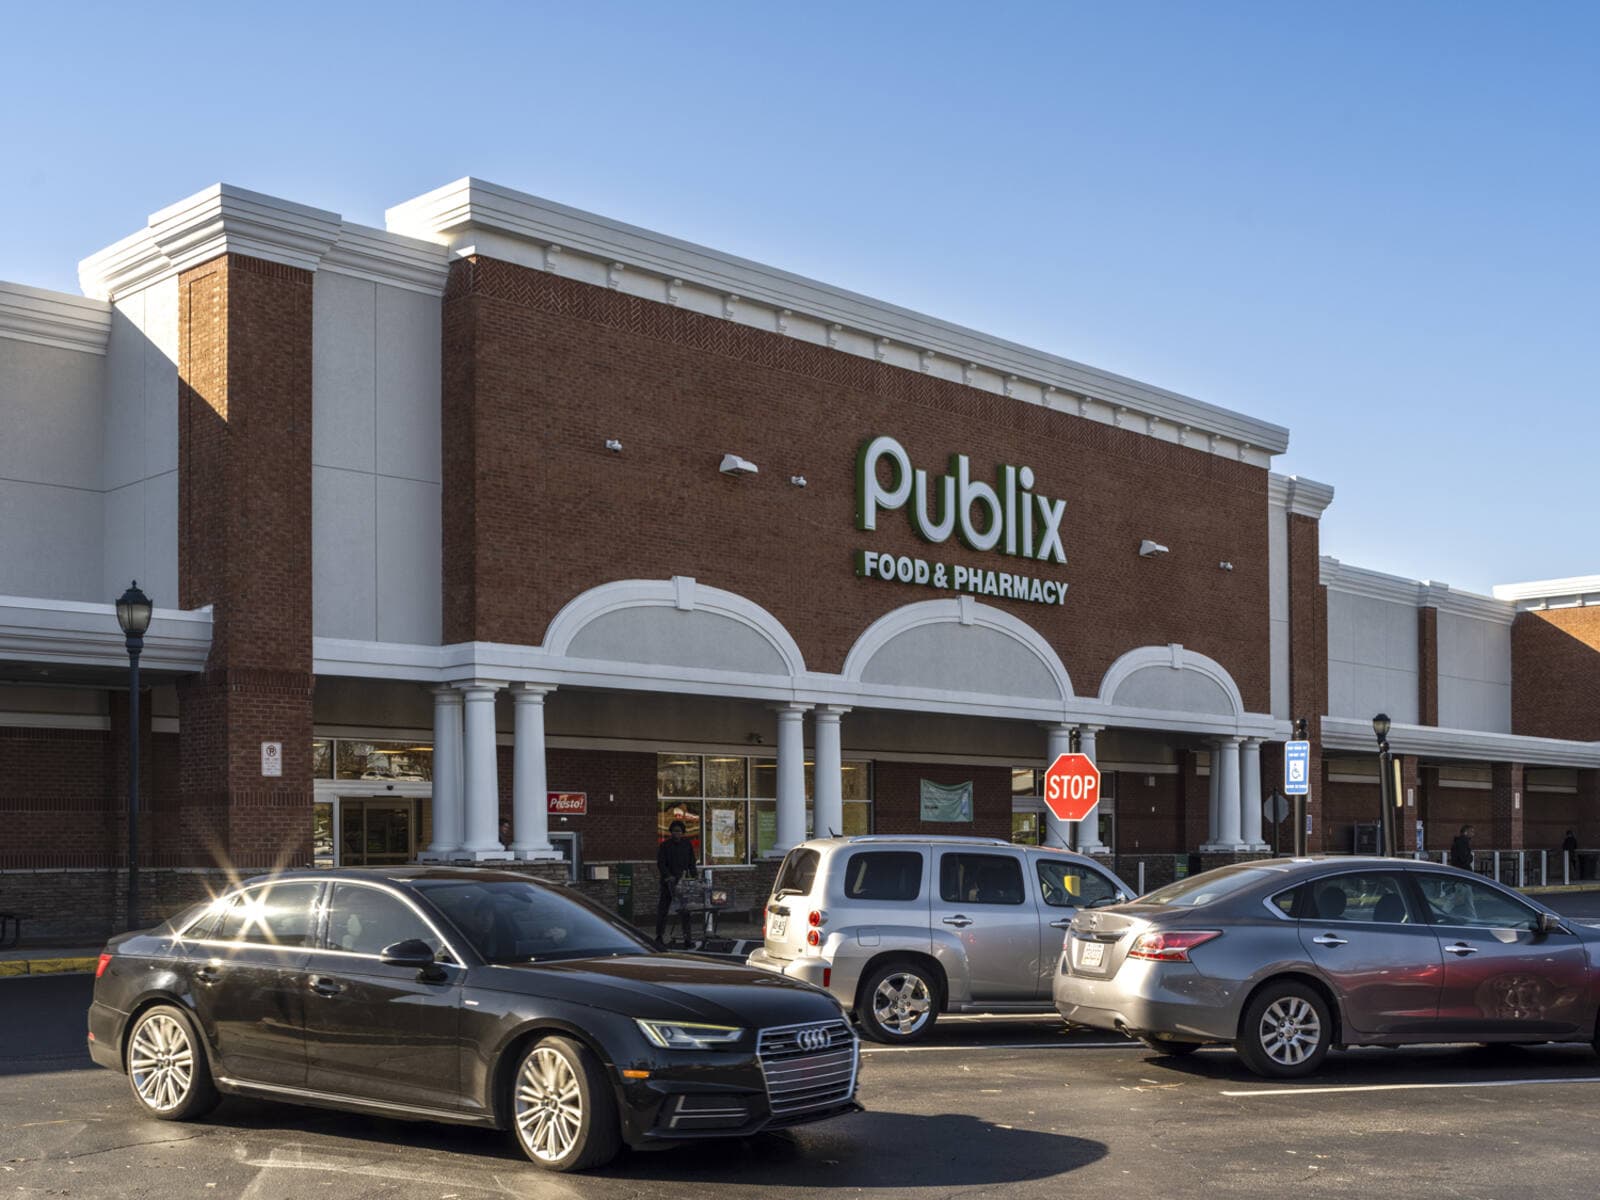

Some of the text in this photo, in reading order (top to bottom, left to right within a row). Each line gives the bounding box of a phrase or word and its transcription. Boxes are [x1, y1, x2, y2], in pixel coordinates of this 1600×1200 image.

[862, 436, 1067, 564] Publix
[864, 551, 1069, 605] FOOD & PHARMACY
[1048, 774, 1096, 800] STOP
